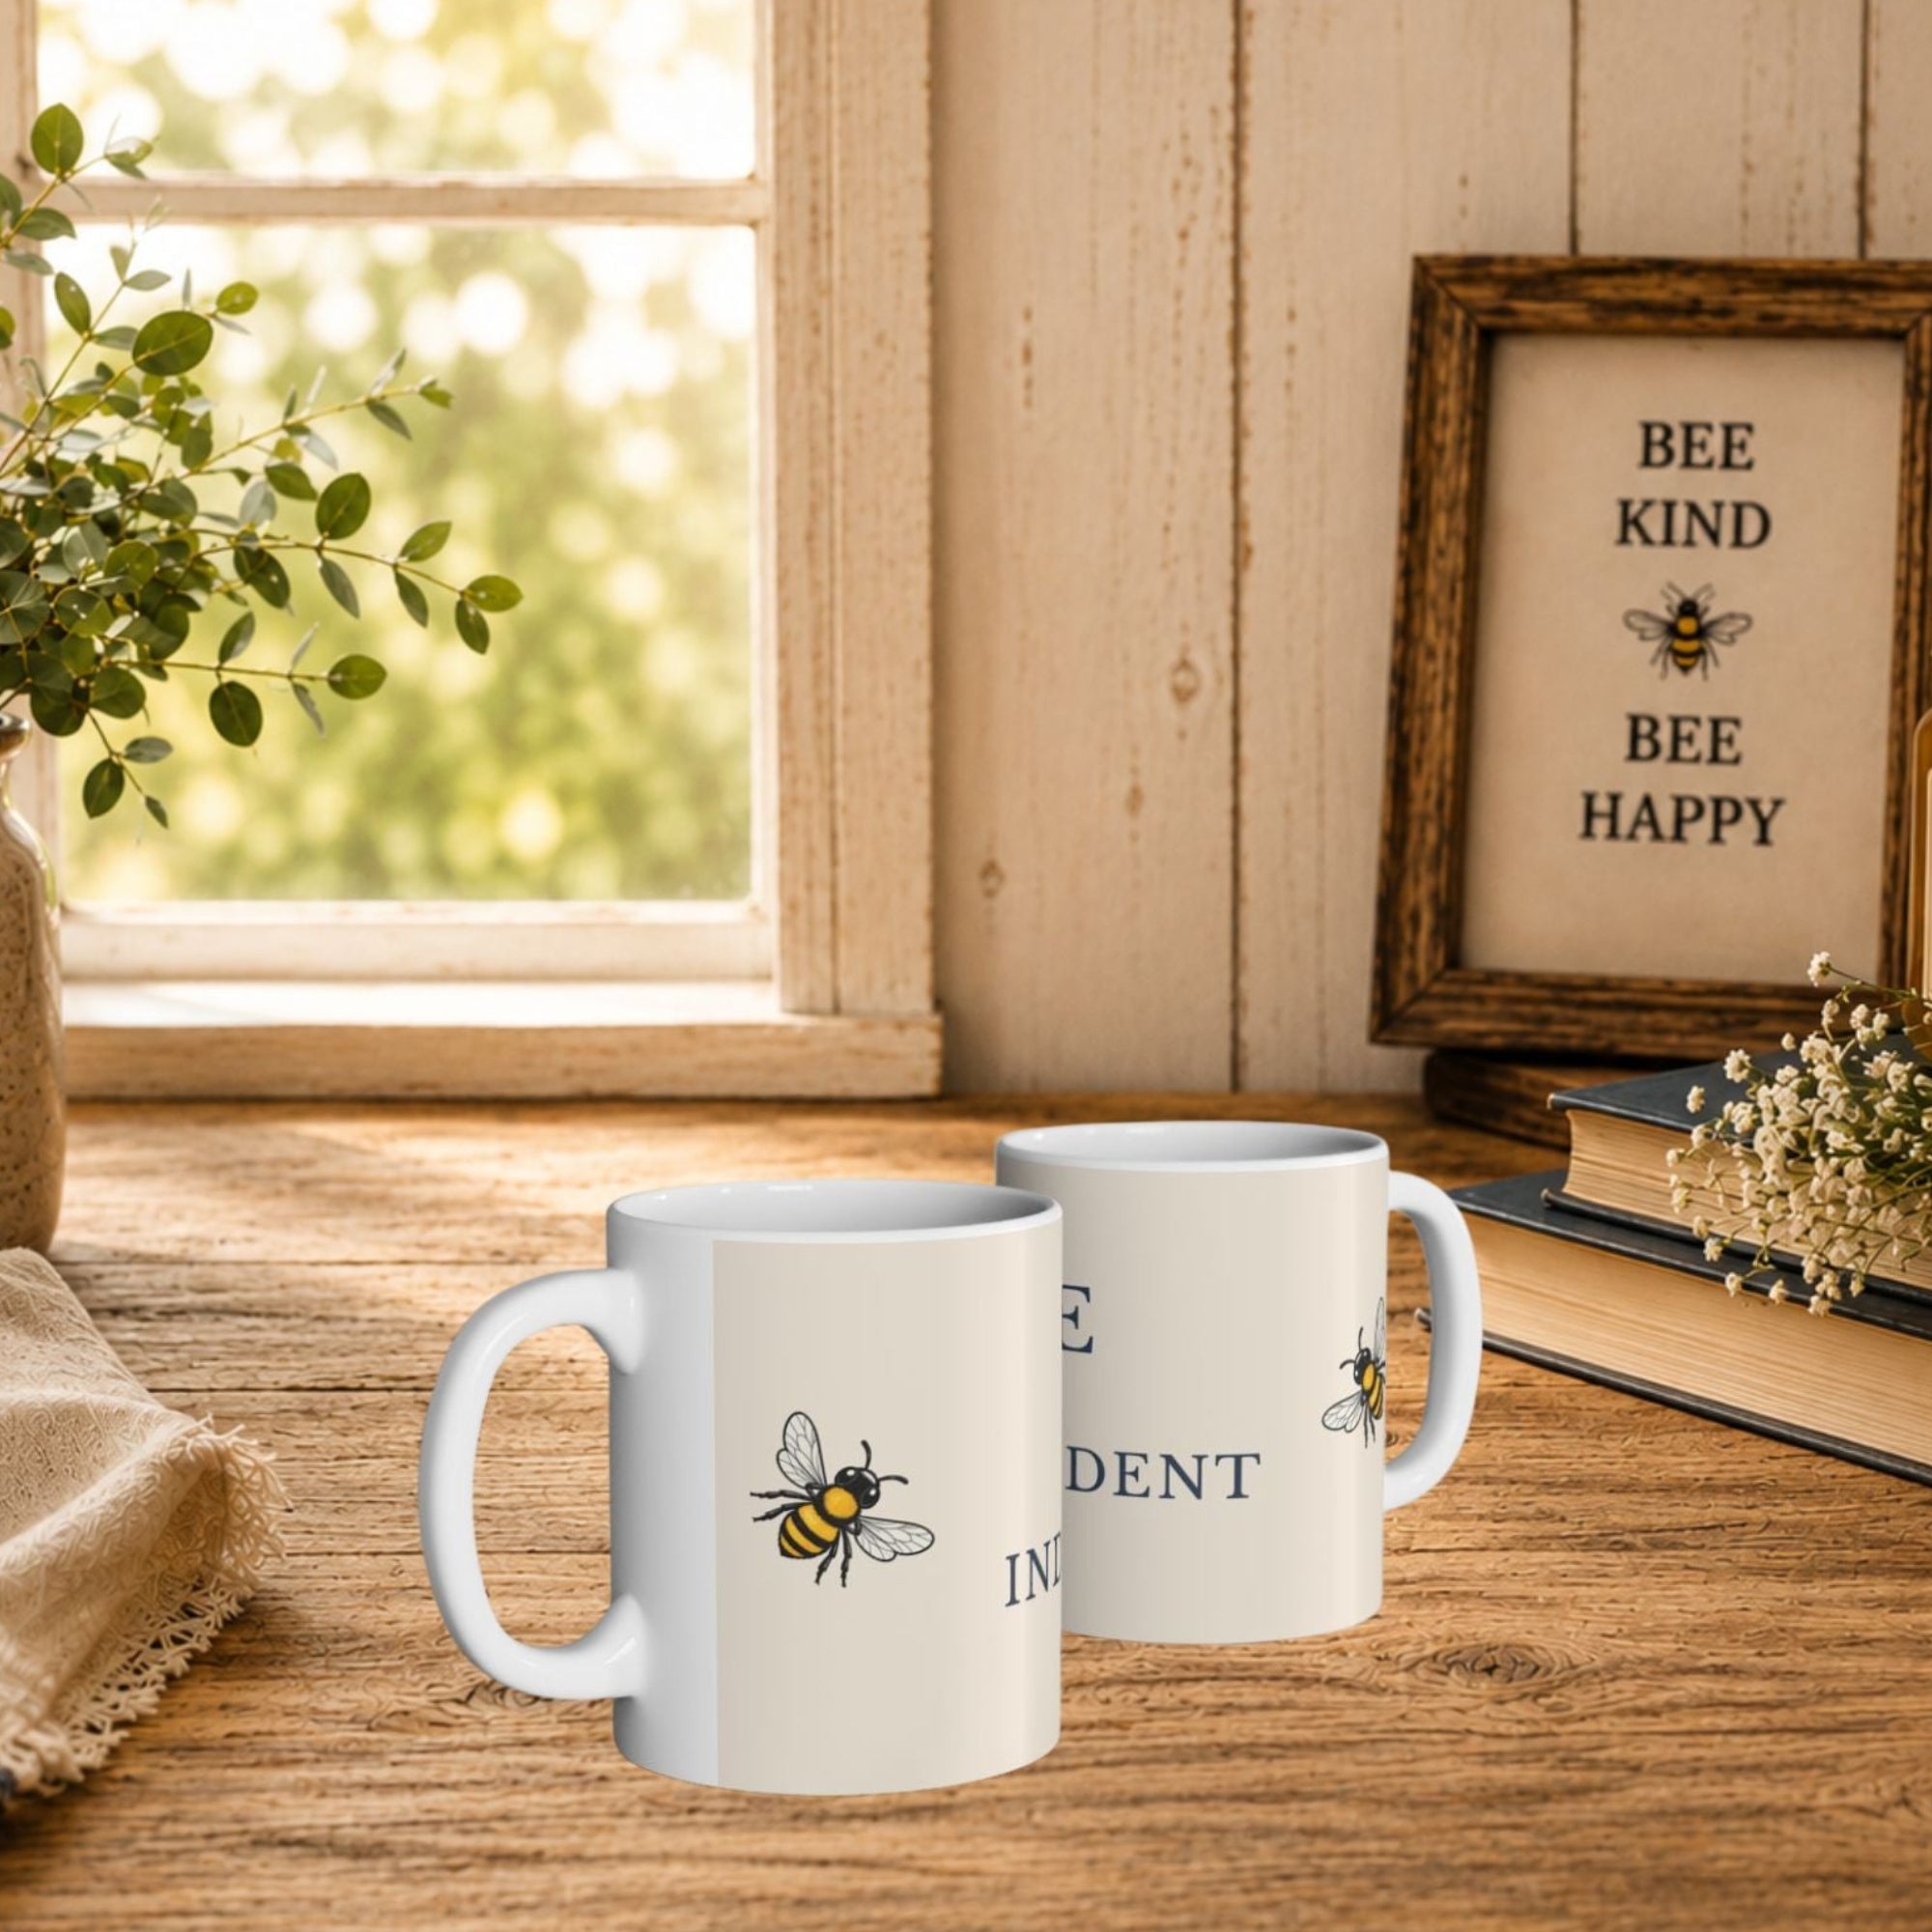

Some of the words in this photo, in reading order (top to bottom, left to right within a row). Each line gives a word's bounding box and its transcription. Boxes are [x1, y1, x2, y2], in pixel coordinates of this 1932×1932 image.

[1638, 420, 1754, 471] BEE
[1615, 497, 1772, 549] KIND
[1625, 713, 1743, 765] BEE
[1579, 790, 1785, 846] HAPPY
[1065, 1445, 1262, 1500] DENT
